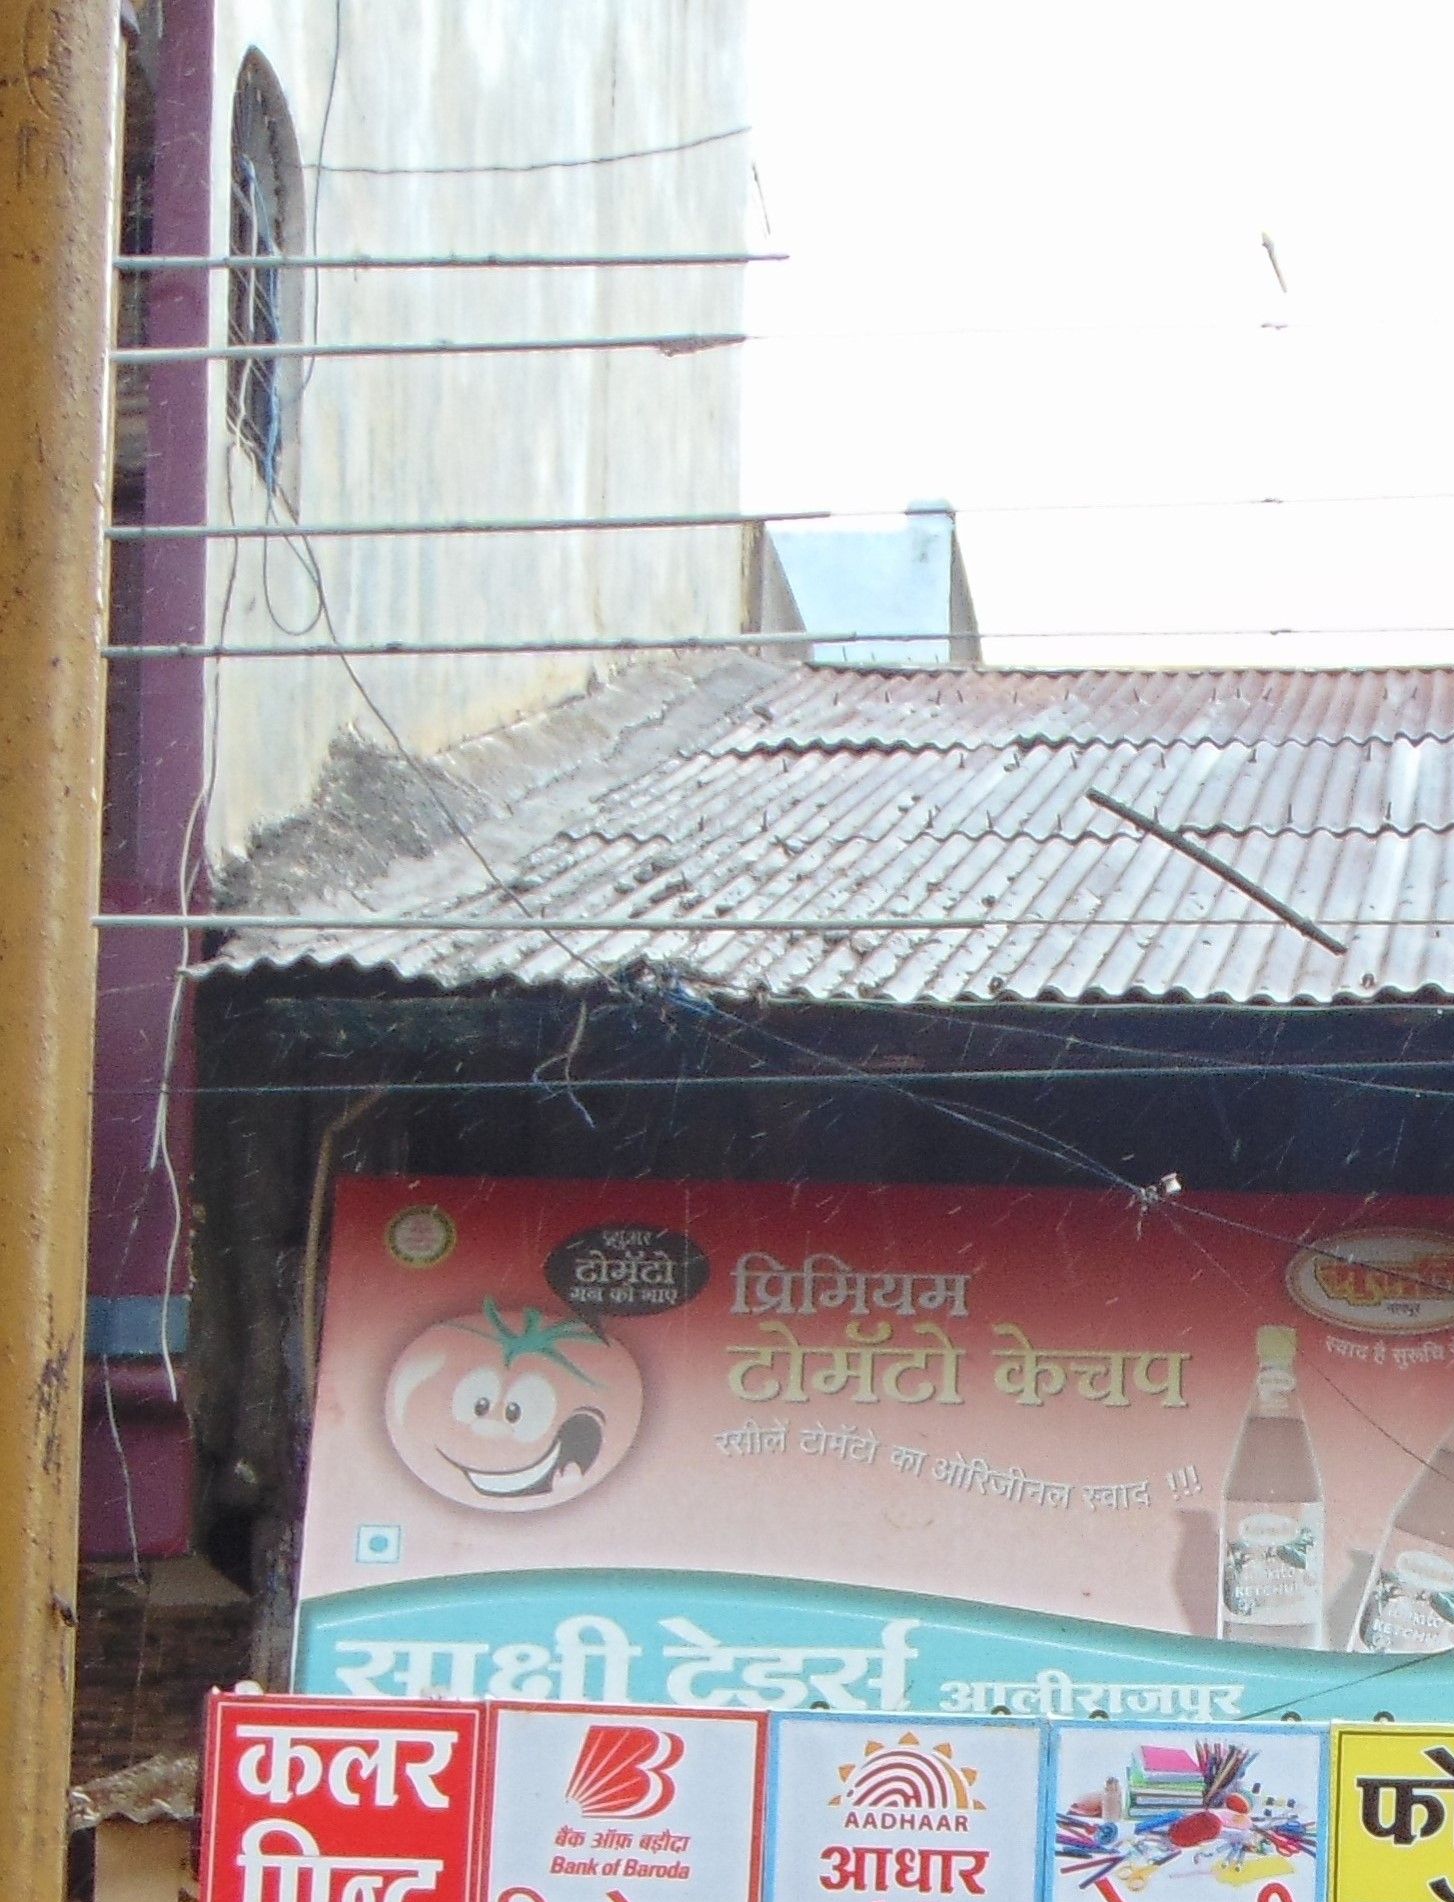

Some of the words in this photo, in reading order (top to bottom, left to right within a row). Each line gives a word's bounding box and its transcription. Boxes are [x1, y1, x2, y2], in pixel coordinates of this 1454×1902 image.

[730, 1252, 971, 1317] प्रिमियम
[726, 1321, 967, 1405] टोमॅटो
[991, 1322, 1191, 1408] केचप
[800, 1420, 880, 1464] टोमॅटो
[891, 1444, 929, 1478] का
[1082, 1478, 1151, 1512] स्वाद
[335, 1614, 642, 1702] साक्षी
[236, 1724, 459, 1808] कलर
[844, 1811, 969, 1833] AADHAAR
[550, 1855, 599, 1875] Bank
[602, 1859, 622, 1877] of
[623, 1858, 691, 1880] Baroda
[819, 1845, 990, 1895] आधार
